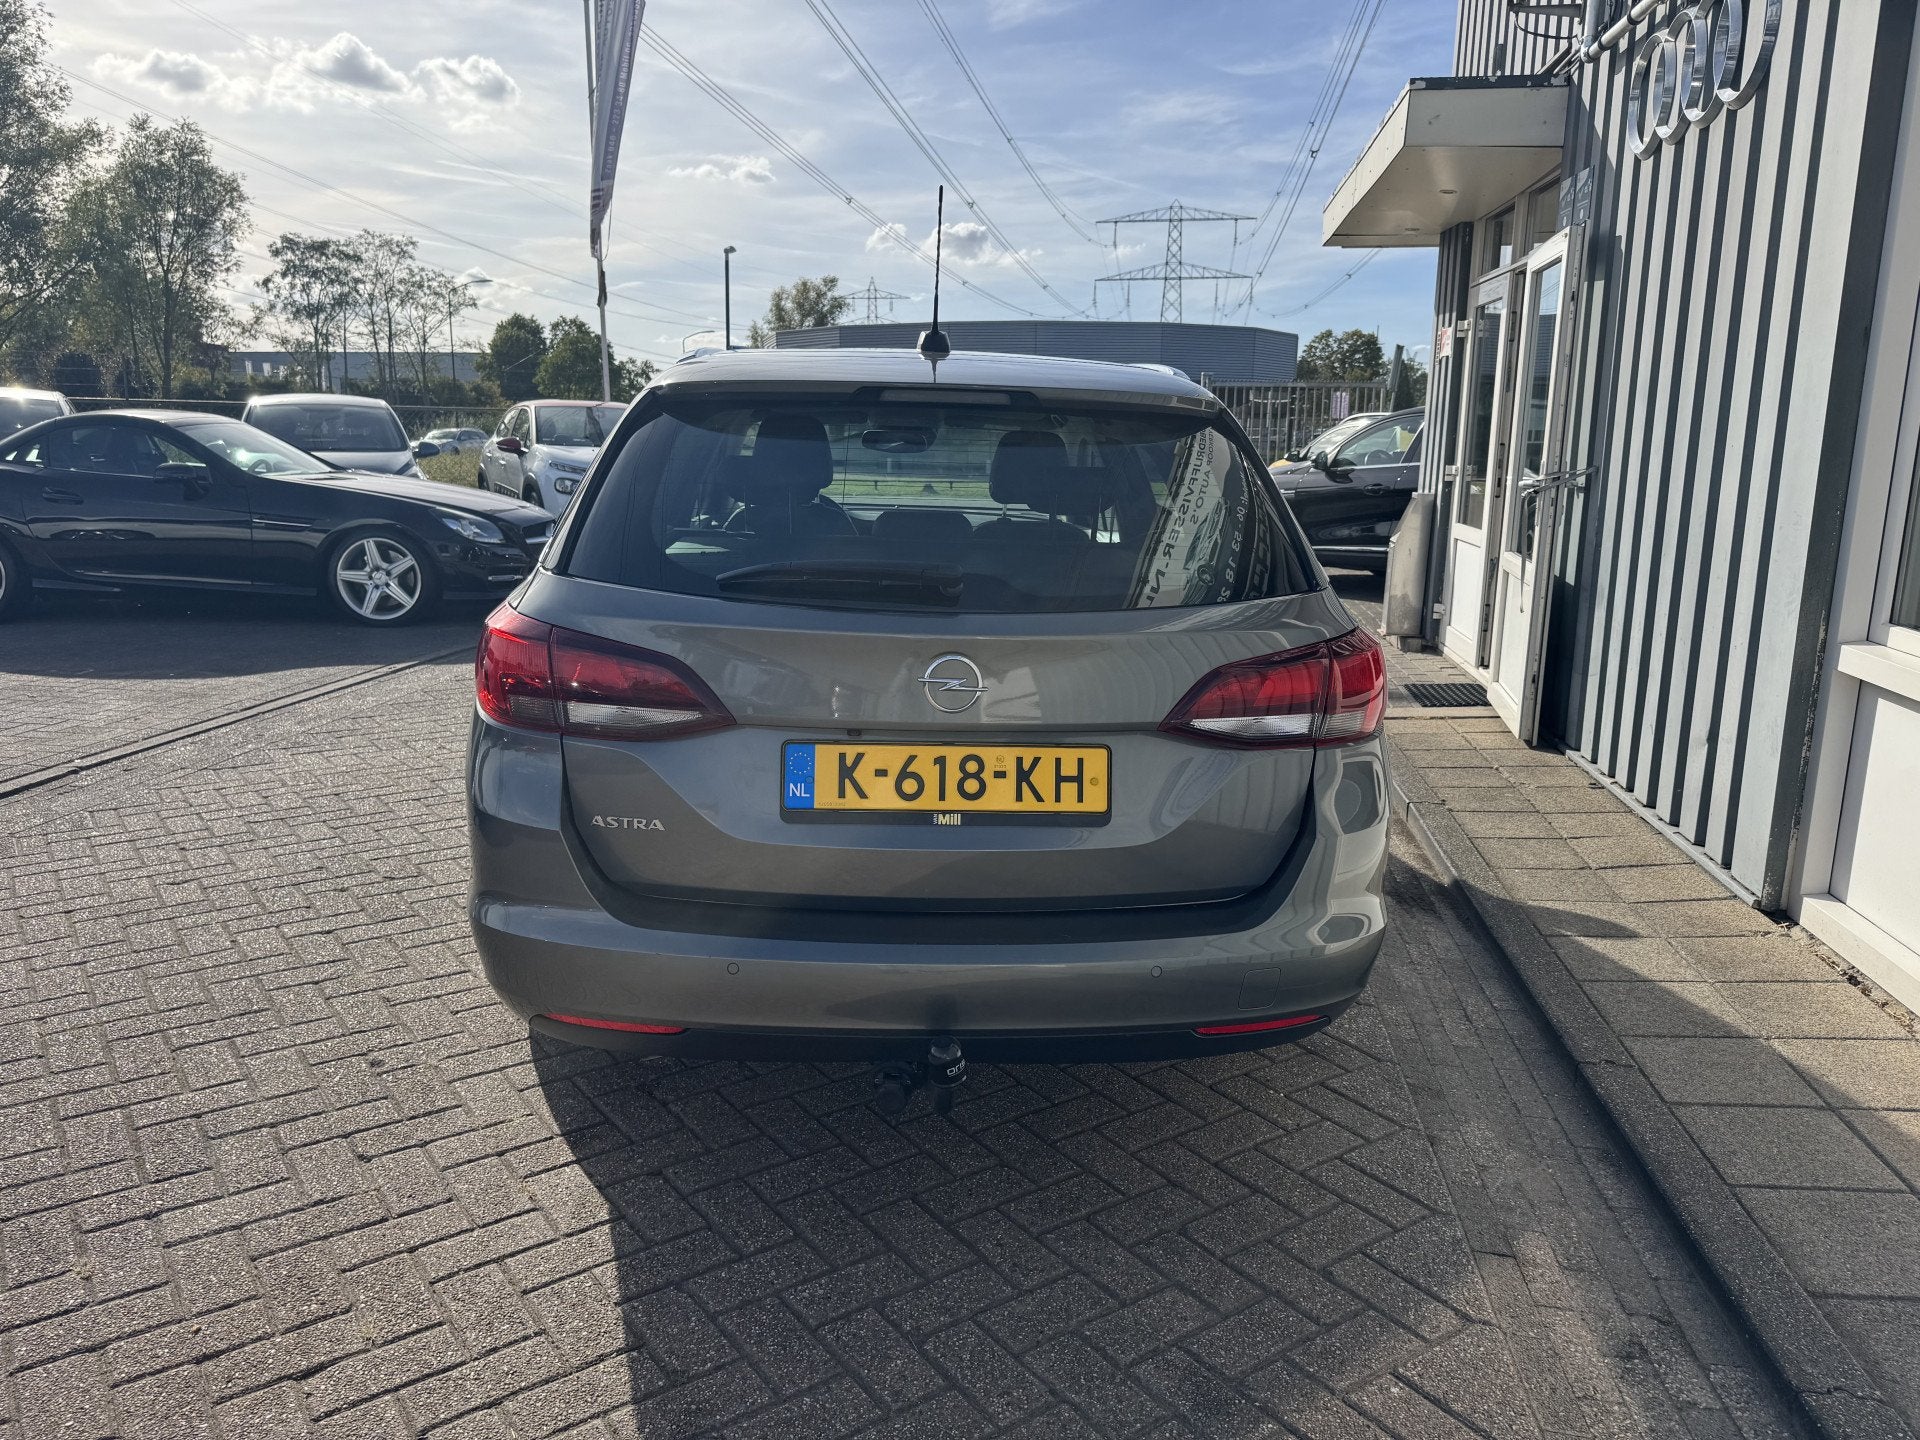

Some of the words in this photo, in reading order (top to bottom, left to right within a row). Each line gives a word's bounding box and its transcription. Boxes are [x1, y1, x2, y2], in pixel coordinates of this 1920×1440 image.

[789, 783, 811, 797] NL
[837, 752, 1085, 804] K-618-KH
[591, 815, 666, 831] ASTRA
[938, 813, 961, 826] Mill
